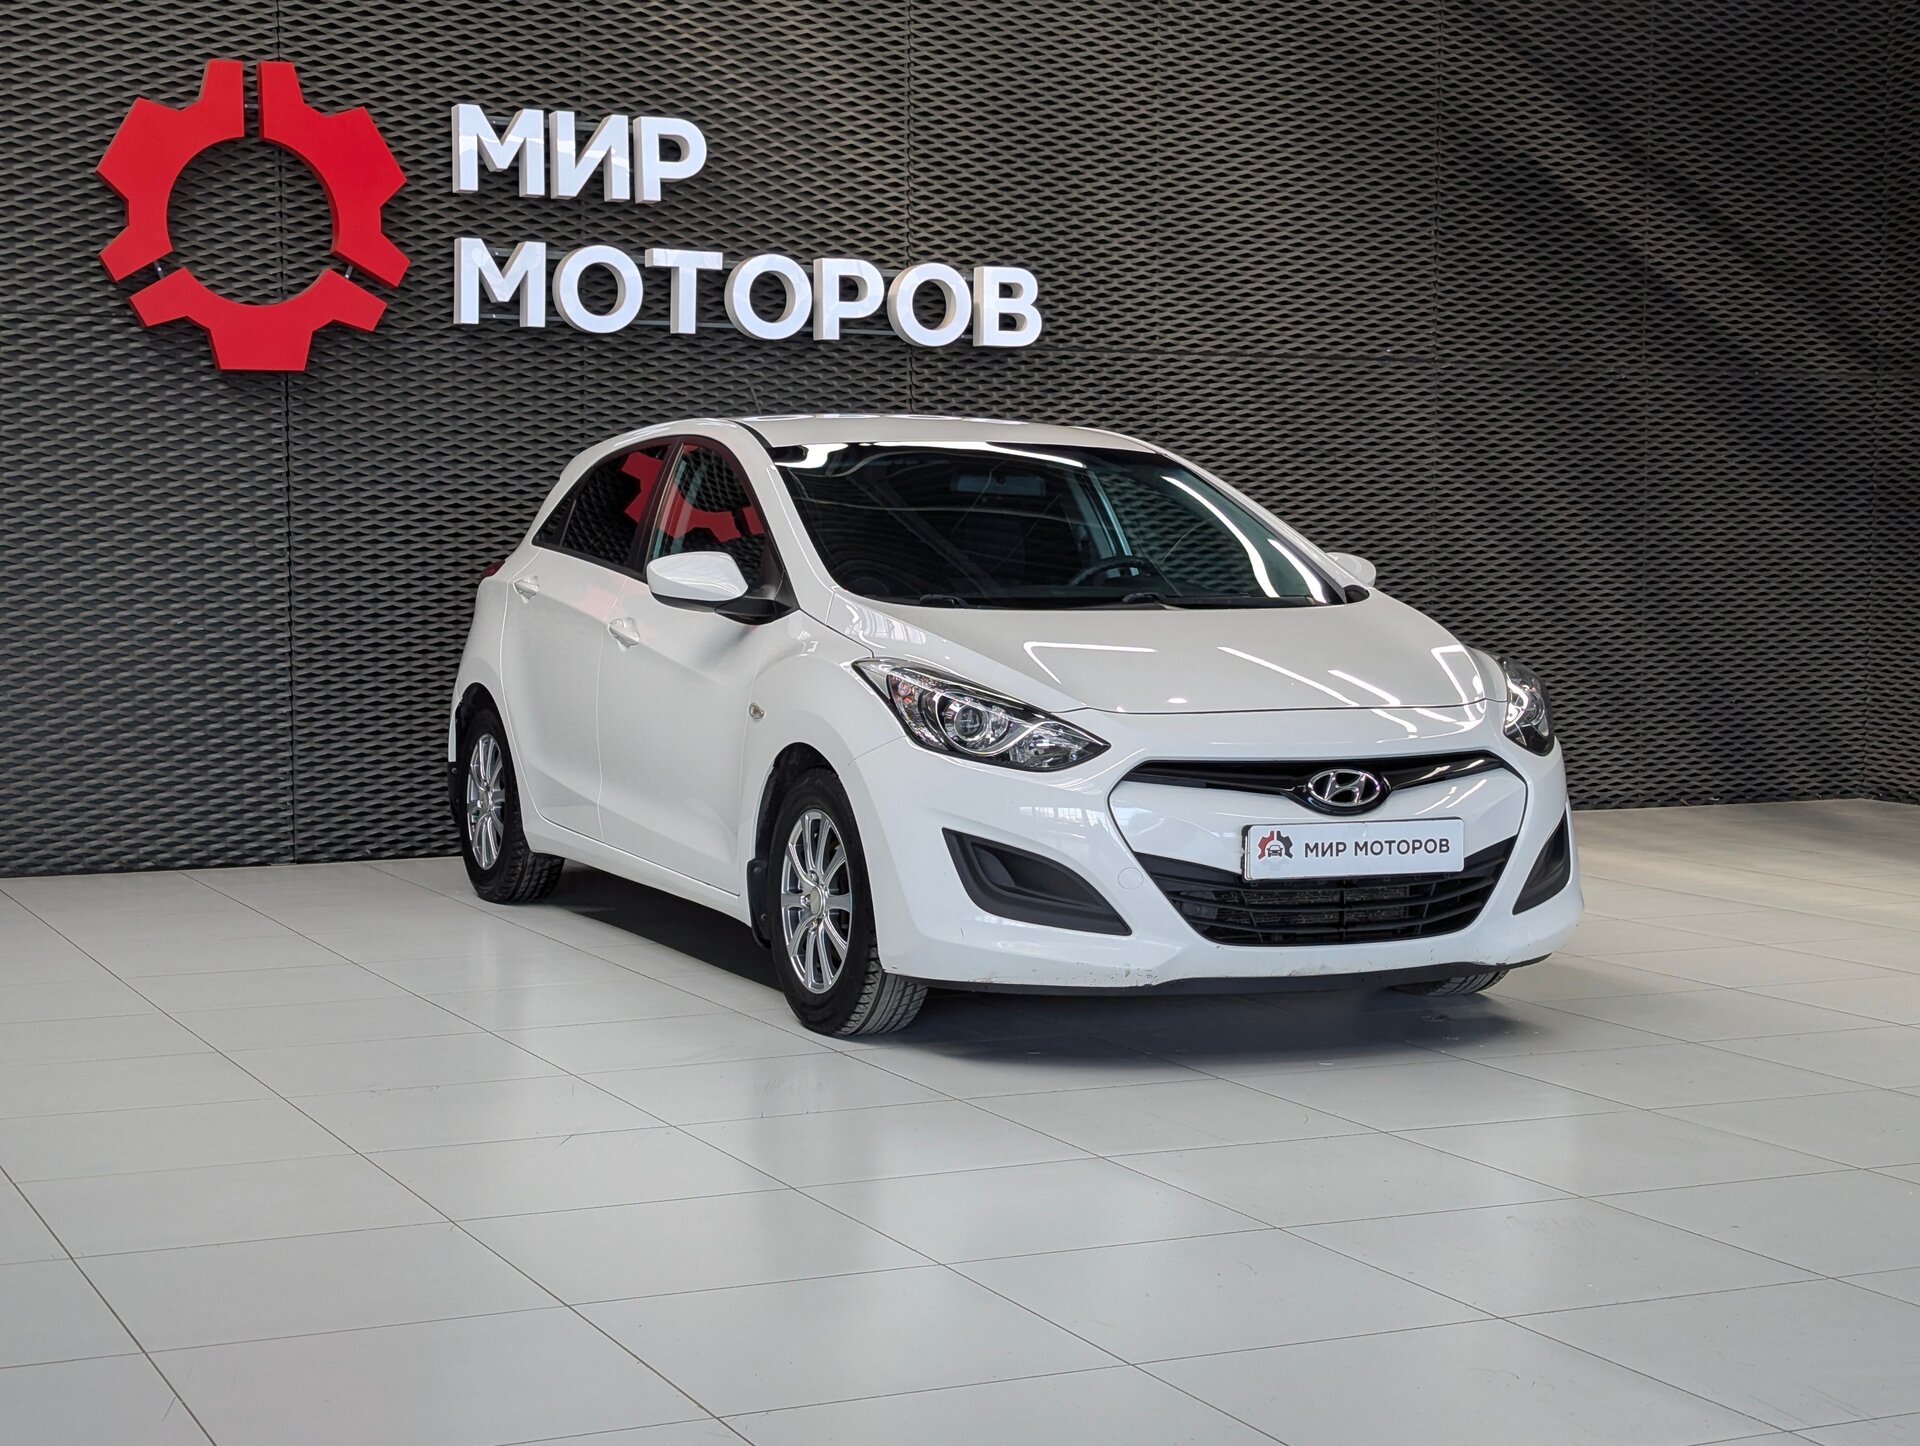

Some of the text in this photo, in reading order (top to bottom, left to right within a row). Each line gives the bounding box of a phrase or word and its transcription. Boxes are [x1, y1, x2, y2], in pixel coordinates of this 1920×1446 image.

[452, 103, 707, 203] МИР
[453, 237, 1043, 347] МОТОРОВ
[1304, 838, 1451, 858] МИР МОТОРОВ
